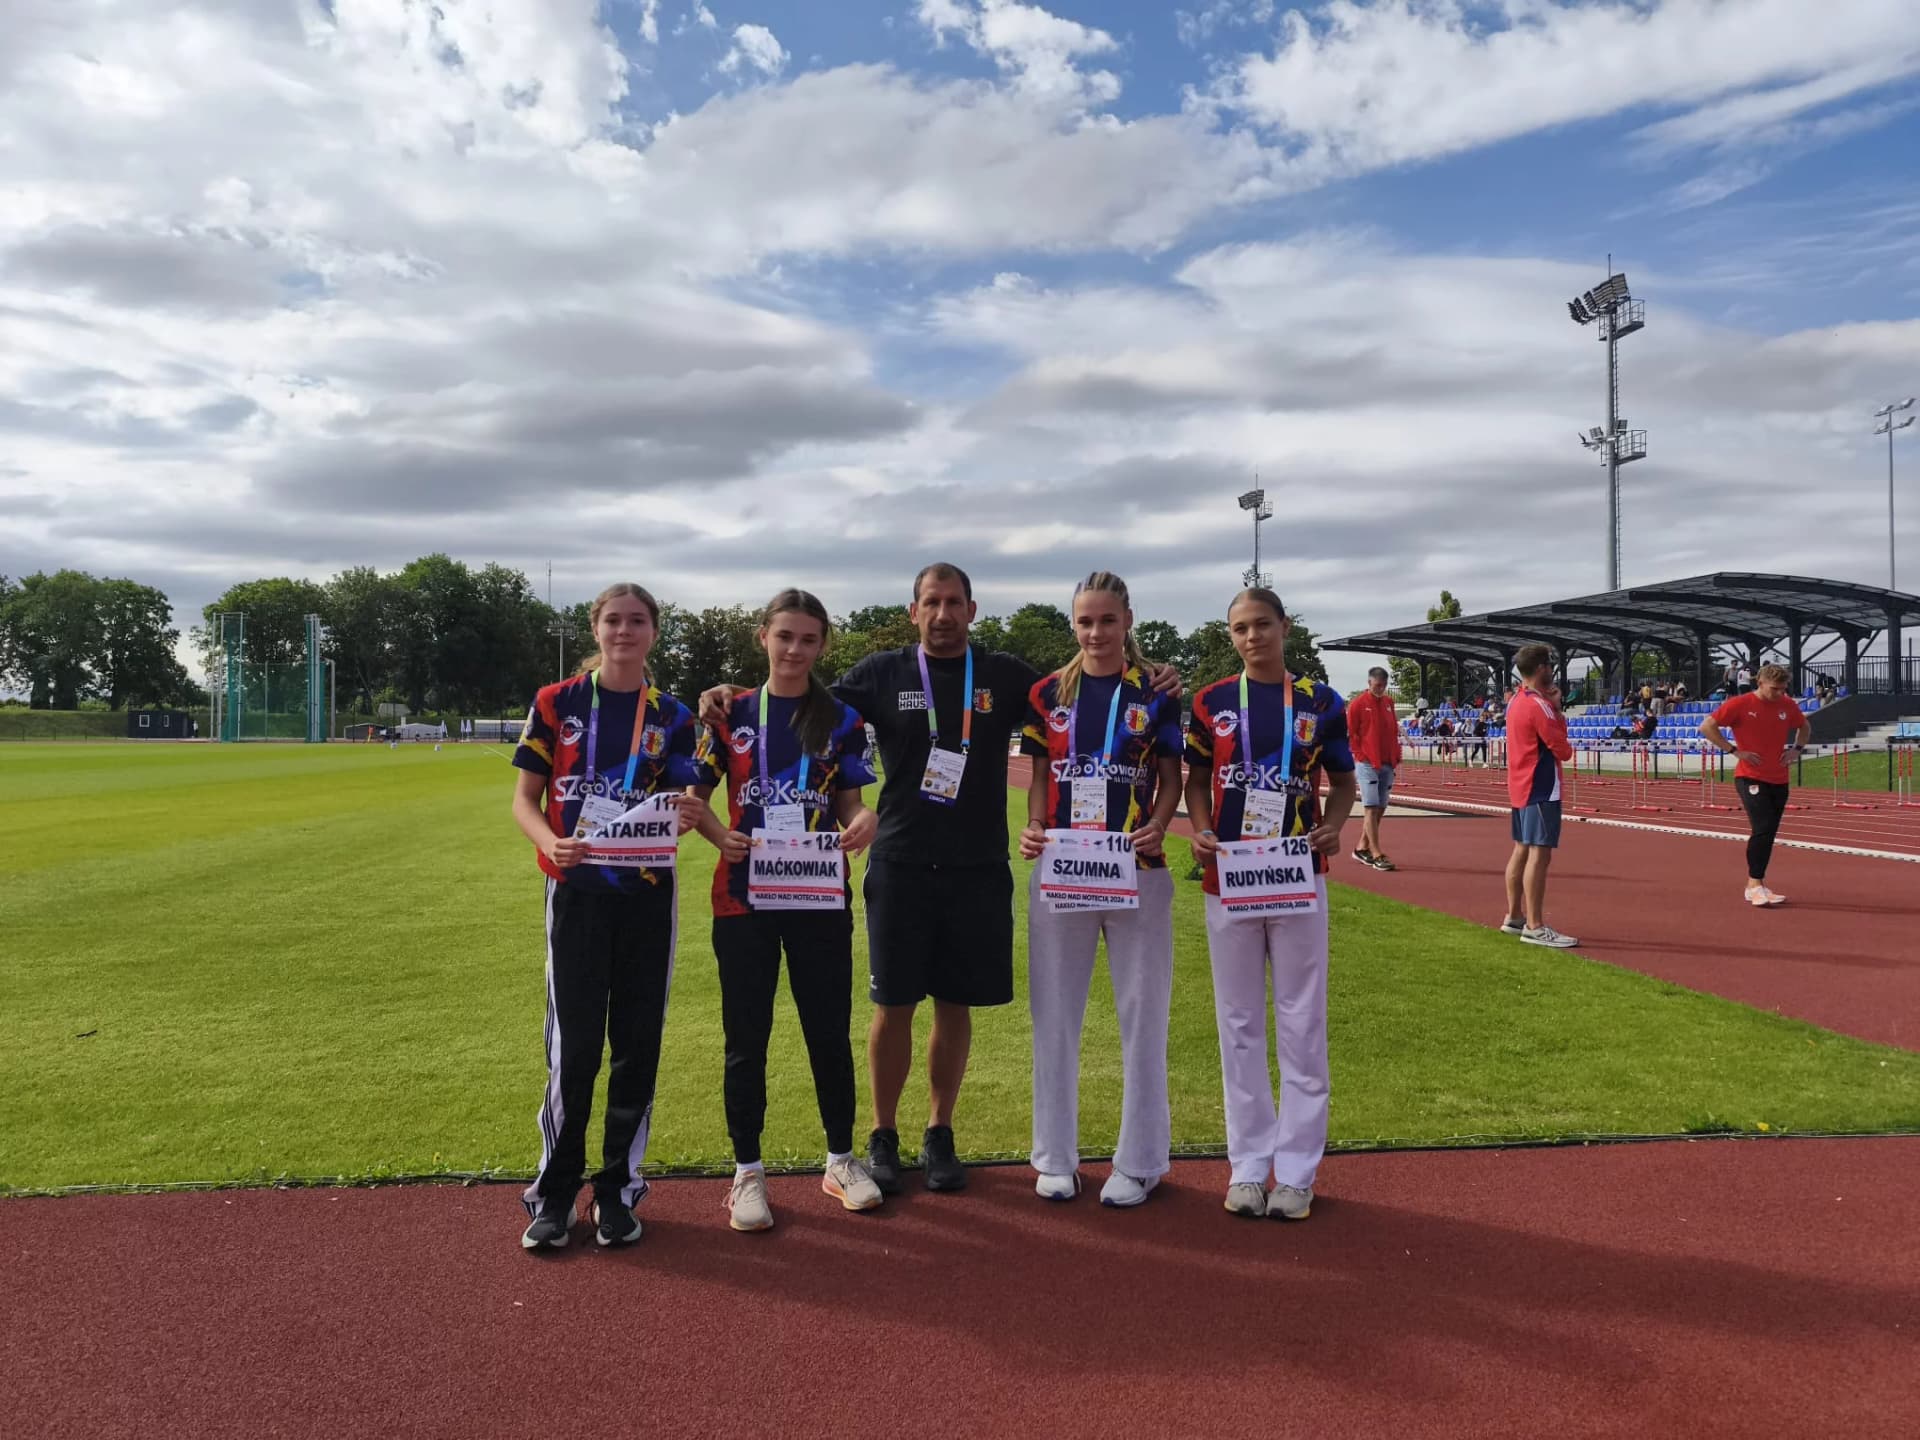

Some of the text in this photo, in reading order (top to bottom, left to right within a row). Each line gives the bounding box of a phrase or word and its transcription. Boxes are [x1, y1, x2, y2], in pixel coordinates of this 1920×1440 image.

[899, 700, 928, 710] HAUS
[1107, 835, 1132, 853] 110
[1281, 838, 1308, 856] 126
[754, 857, 838, 877] MAĆKOWIAK
[1053, 859, 1121, 878] SZUMNA
[1225, 865, 1307, 888] RUDYŃSKA
